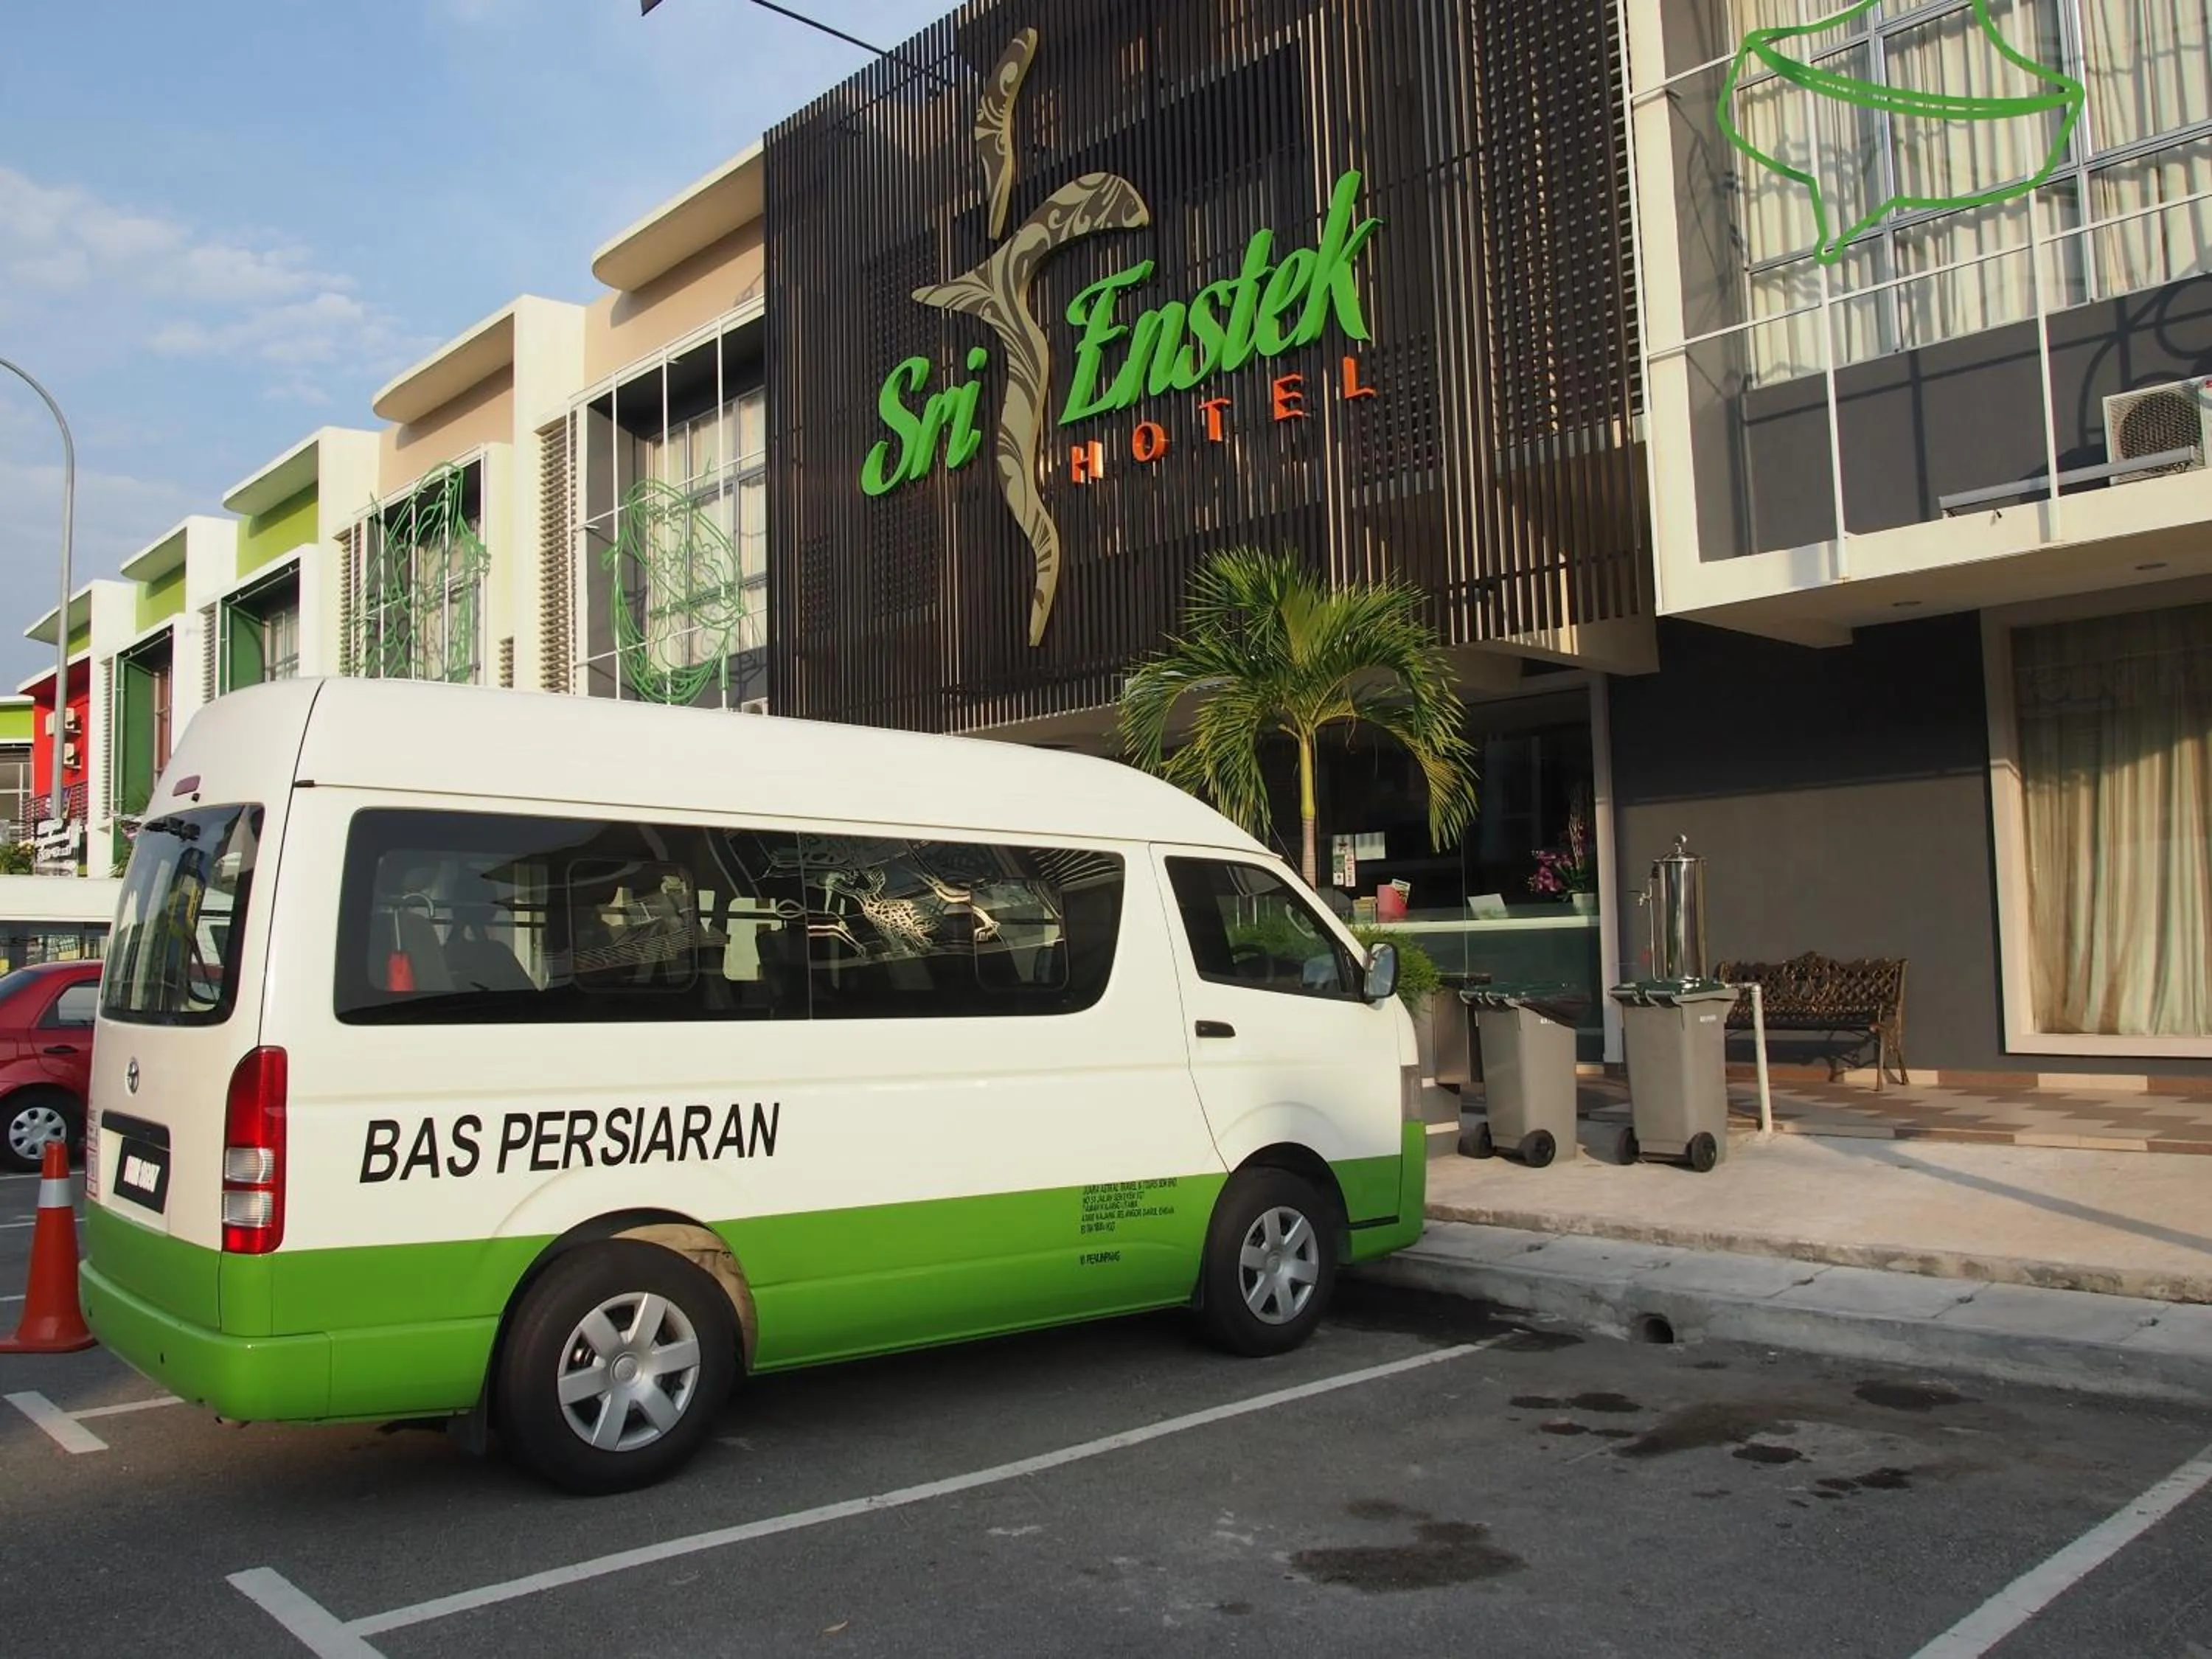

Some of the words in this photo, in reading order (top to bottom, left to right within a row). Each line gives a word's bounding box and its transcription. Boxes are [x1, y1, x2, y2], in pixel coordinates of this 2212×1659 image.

[861, 347, 987, 496] Sri
[1059, 170, 1383, 425] Enstek
[1071, 357, 1376, 484] HOTEL
[359, 1114, 482, 1183] BAS
[497, 1102, 779, 1174] PERSIARAN
